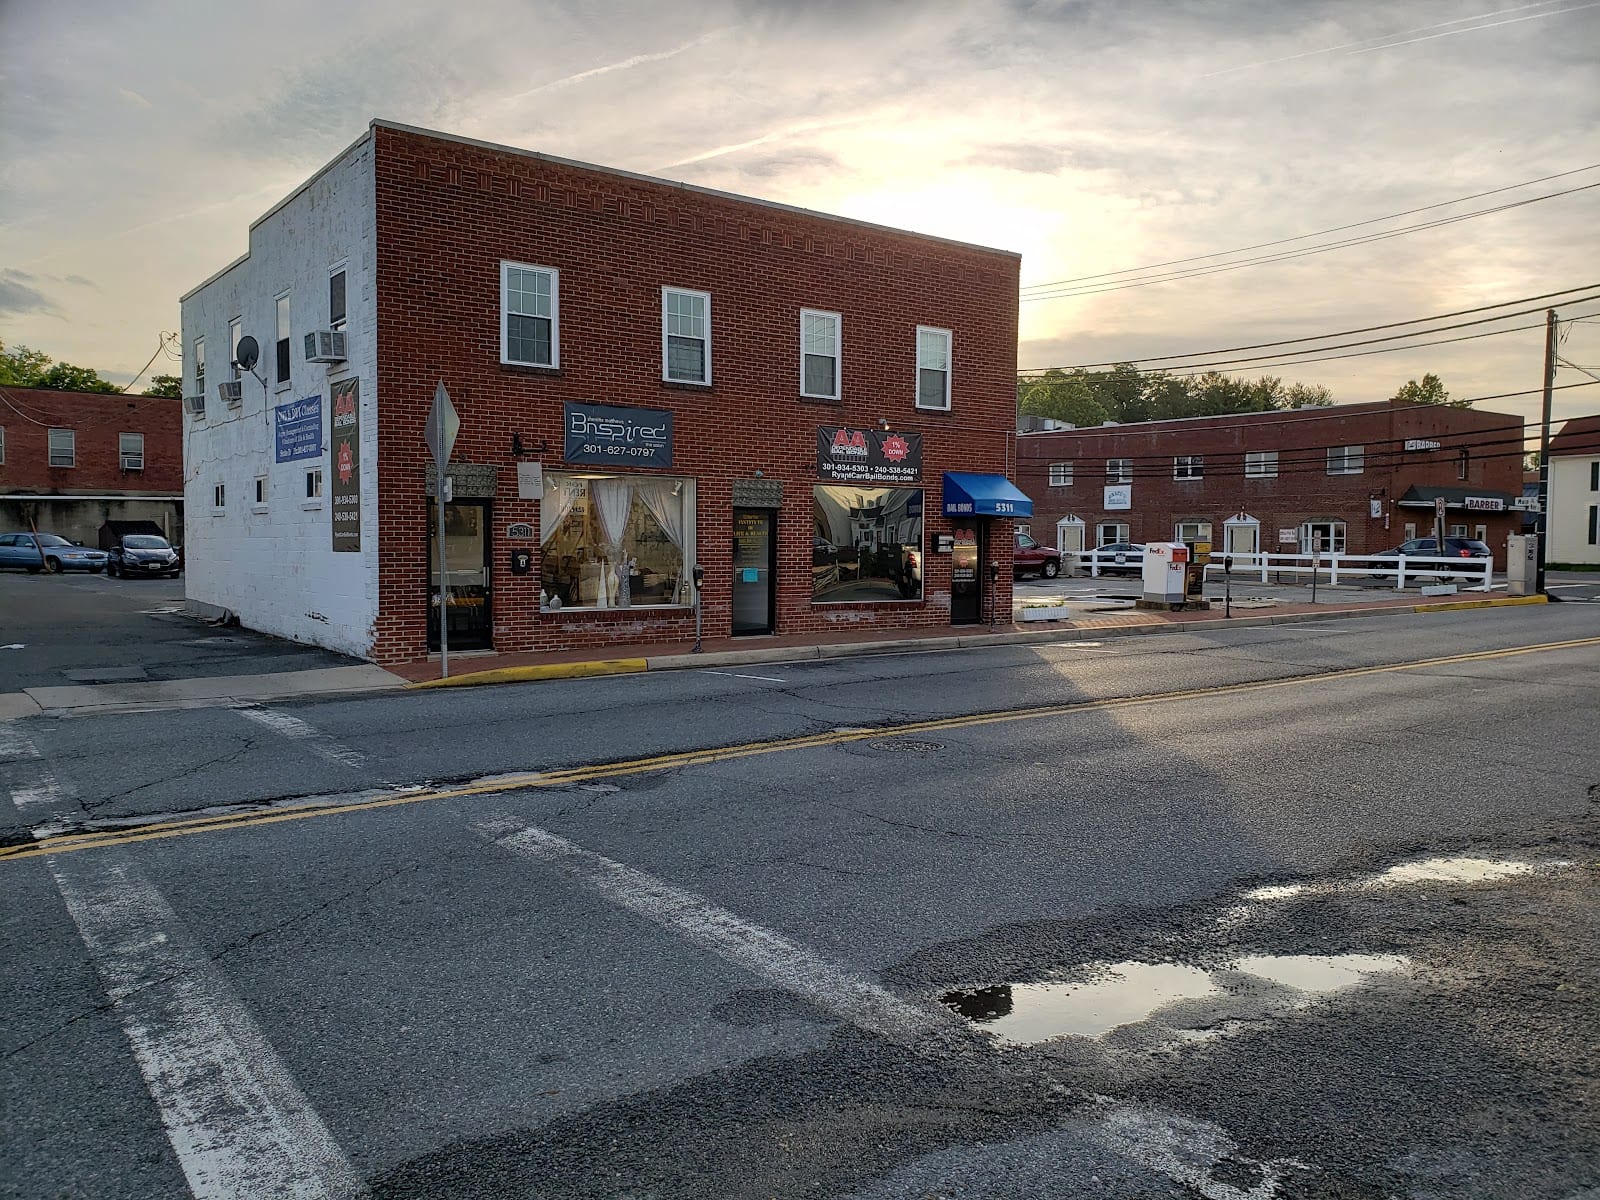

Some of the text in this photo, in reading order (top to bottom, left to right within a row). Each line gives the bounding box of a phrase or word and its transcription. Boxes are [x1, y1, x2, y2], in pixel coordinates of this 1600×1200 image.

[583, 444, 655, 457] 301-627-0797
[892, 441, 900, 449] 1%
[822, 463, 918, 475] 301-934-5303 240-538-5421
[946, 503, 973, 513] BAIL BONDS
[995, 503, 1014, 513] 5311
[1469, 499, 1500, 510] BARBER
[512, 526, 530, 538] 5311
